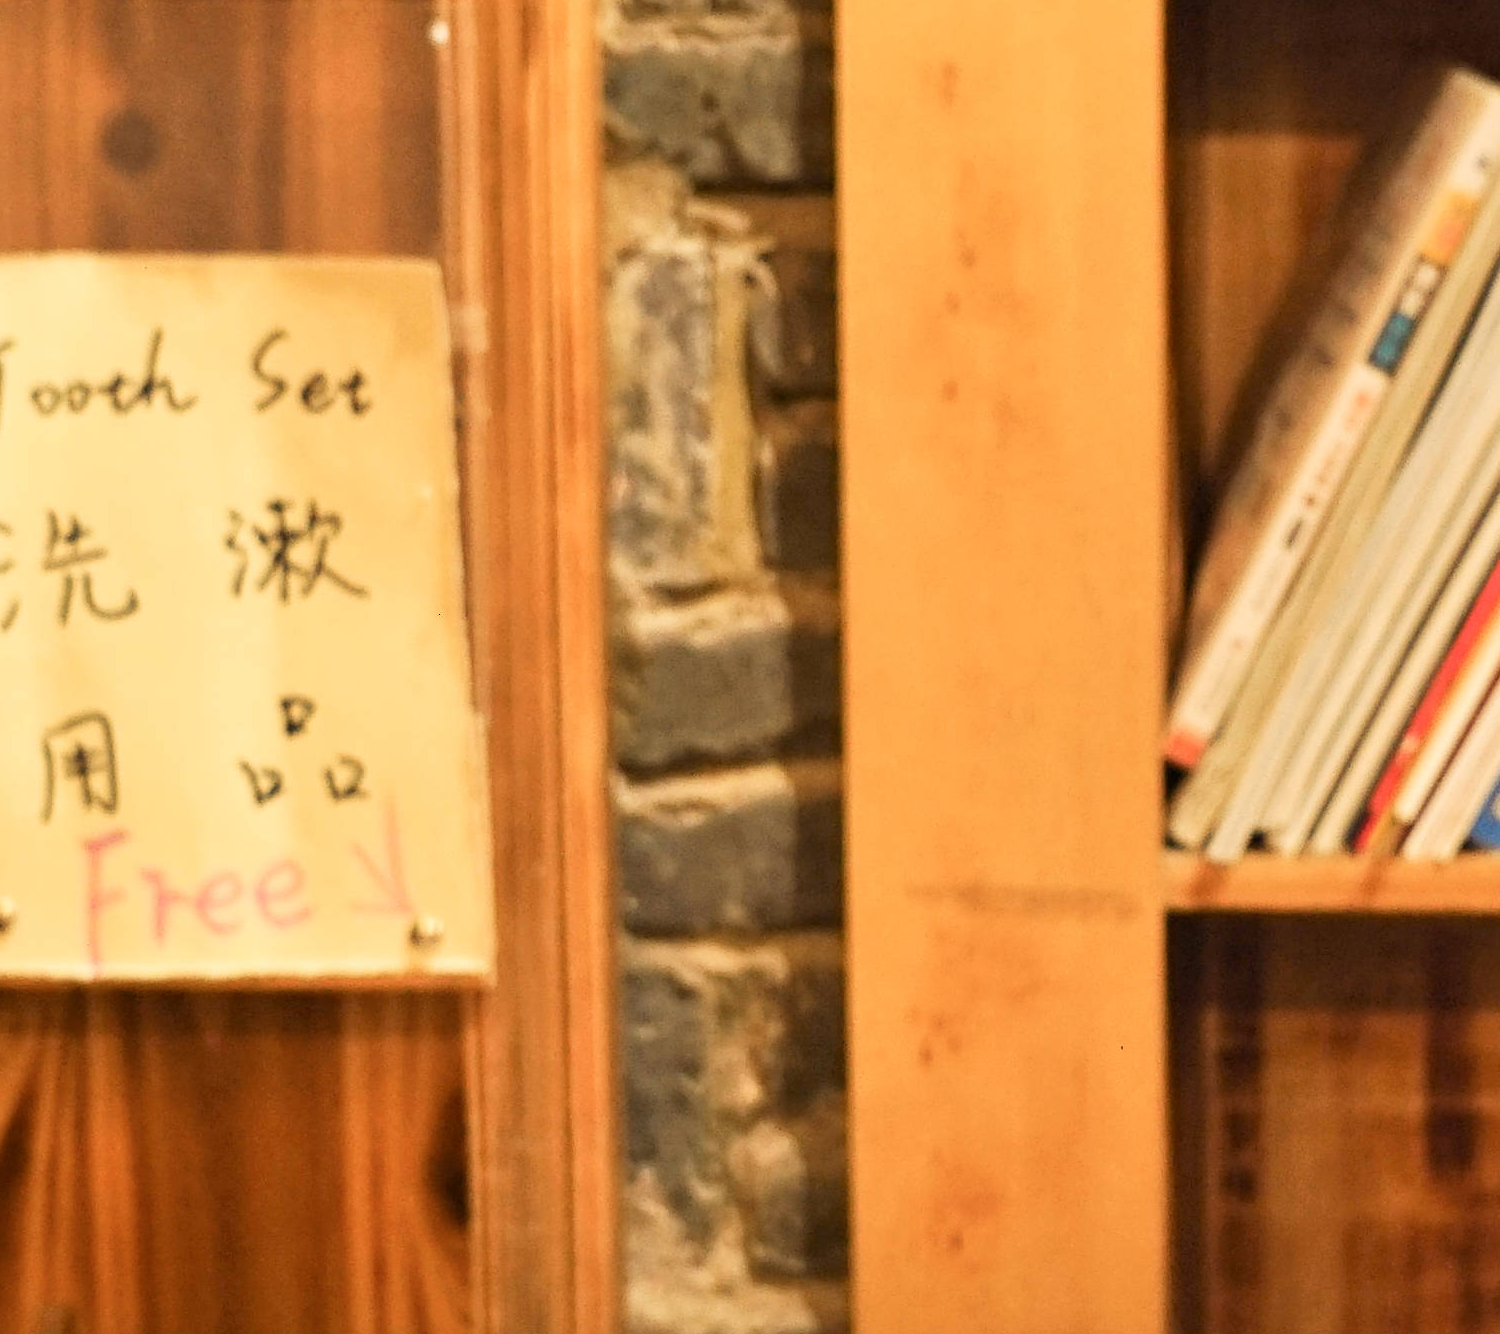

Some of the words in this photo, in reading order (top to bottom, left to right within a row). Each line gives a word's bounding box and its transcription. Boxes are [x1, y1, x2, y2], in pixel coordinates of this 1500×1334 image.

[249, 327, 375, 420] Set
[38, 693, 371, 826] 用品
[79, 827, 316, 977] Free
